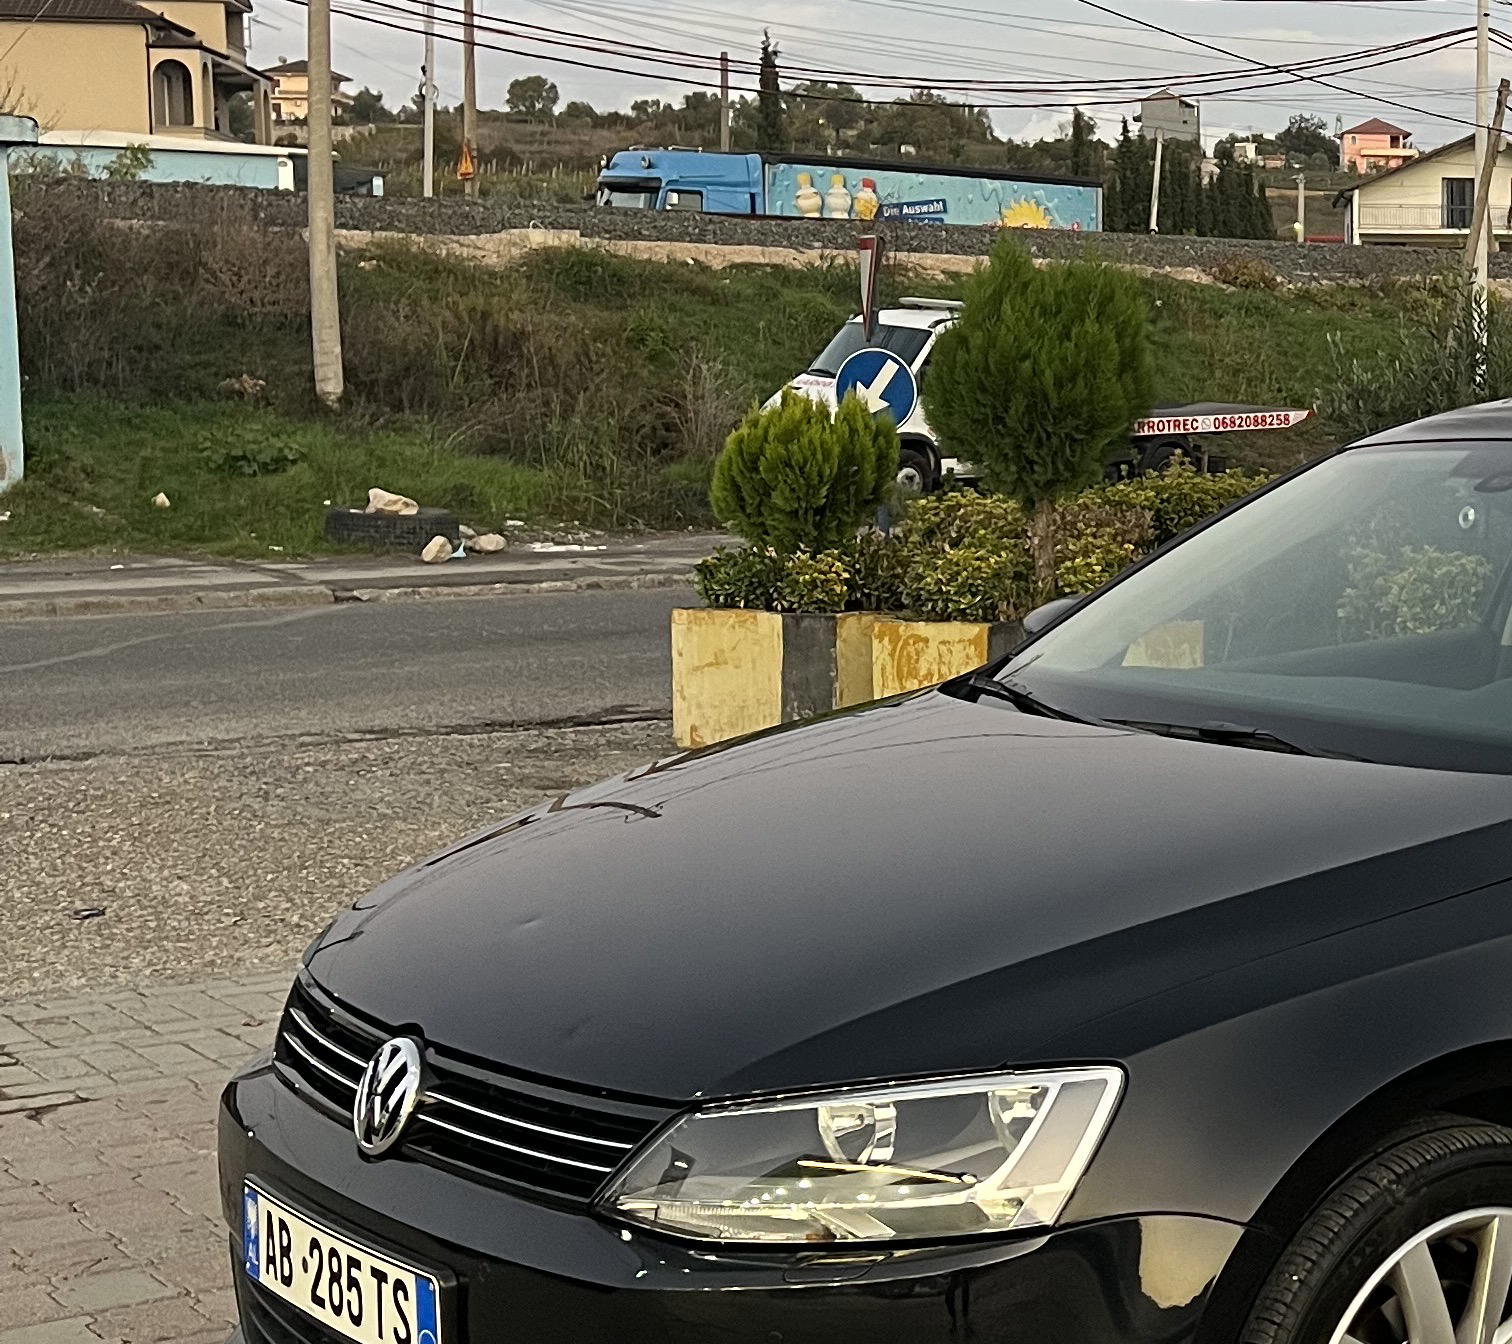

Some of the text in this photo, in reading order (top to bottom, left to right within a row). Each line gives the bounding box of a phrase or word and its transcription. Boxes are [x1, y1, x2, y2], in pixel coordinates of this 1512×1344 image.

[902, 200, 944, 215] Auswahl
[1136, 413, 1291, 434] RROTREC 0682088258
[265, 1209, 293, 1288] AB
